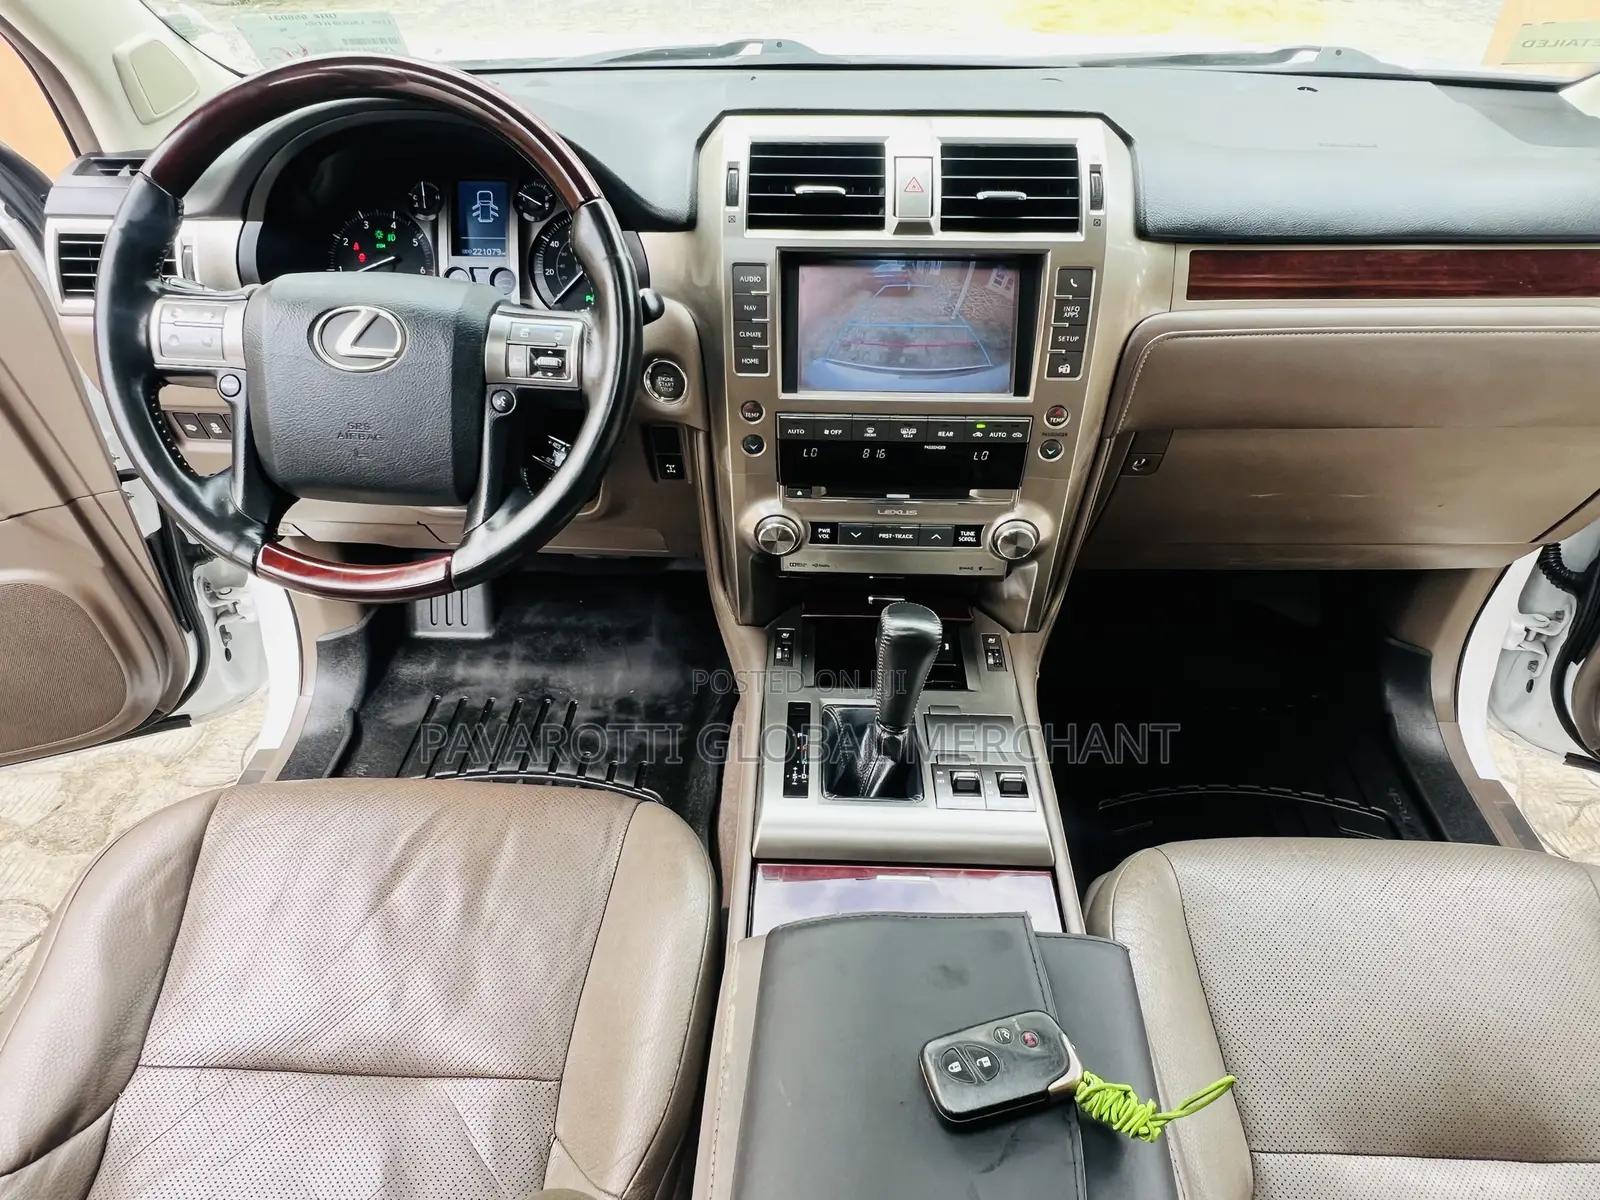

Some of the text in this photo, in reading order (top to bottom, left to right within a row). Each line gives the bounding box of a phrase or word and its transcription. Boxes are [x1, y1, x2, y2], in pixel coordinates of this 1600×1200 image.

[363, 220, 370, 230] 3
[390, 220, 397, 230] 4
[343, 237, 349, 247] 2
[412, 237, 419, 248] 5
[549, 240, 560, 248] 40
[472, 248, 502, 256] 221079
[419, 266, 426, 275] 6
[545, 268, 555, 276] 20
[739, 275, 762, 283] AUDIO
[739, 331, 762, 339] CLIMATE
[741, 357, 760, 365] HOME
[347, 421, 371, 430] SRS
[337, 431, 385, 440] AIRBAG
